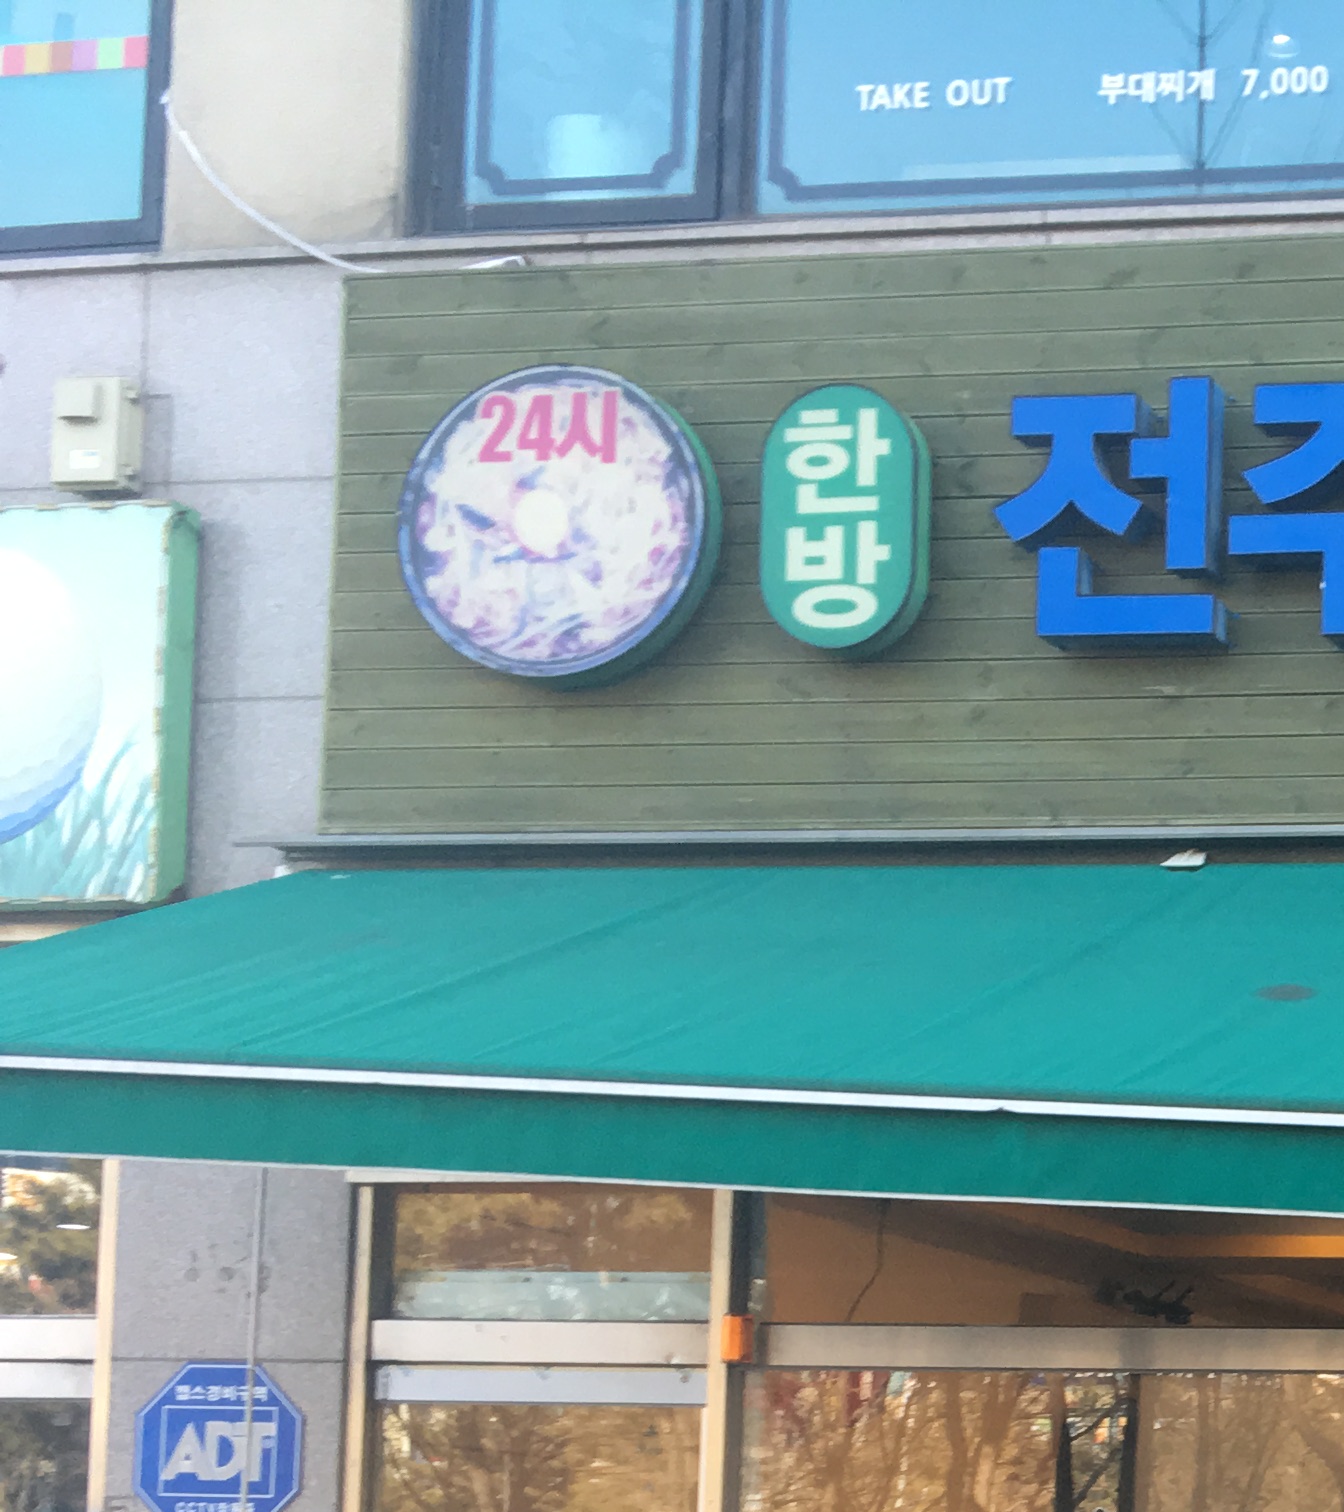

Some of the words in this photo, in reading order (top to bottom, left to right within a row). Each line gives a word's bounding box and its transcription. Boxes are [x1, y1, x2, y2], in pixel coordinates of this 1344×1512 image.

[855, 82, 931, 111] TAKE
[945, 77, 1013, 107] OUT
[1097, 68, 1217, 104] 부대찌개
[1241, 65, 1330, 101] 7,000
[477, 388, 619, 465] 24시
[783, 406, 891, 629] 한방
[159, 1420, 278, 1483] ADT
